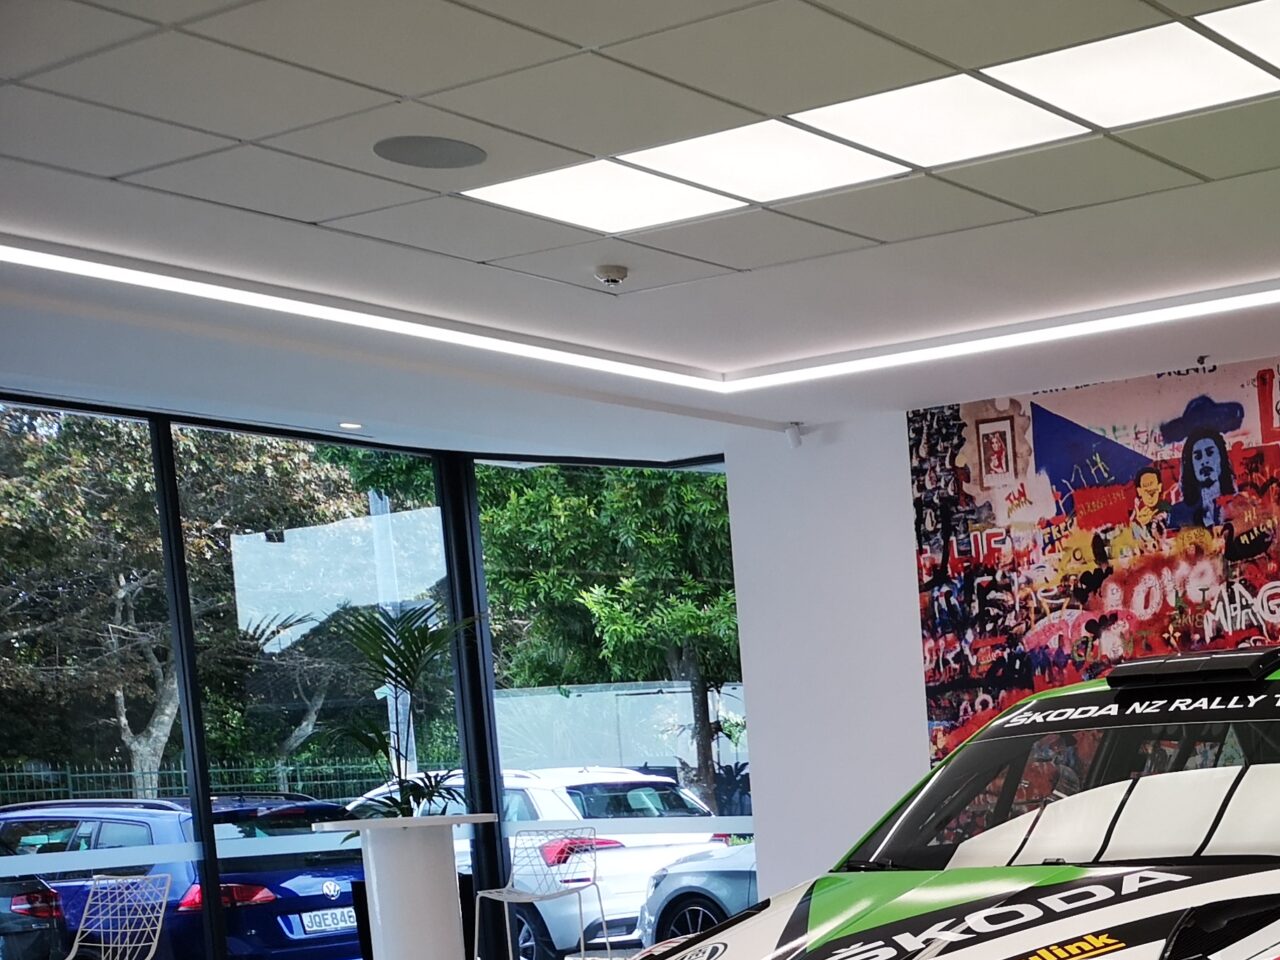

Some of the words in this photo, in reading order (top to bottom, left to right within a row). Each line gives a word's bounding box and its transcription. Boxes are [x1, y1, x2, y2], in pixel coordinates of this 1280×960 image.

[1003, 702, 1118, 728] ŠKODA
[1125, 699, 1163, 714] NZ
[1169, 694, 1269, 713] RALLY
[305, 910, 356, 930] JQE846
